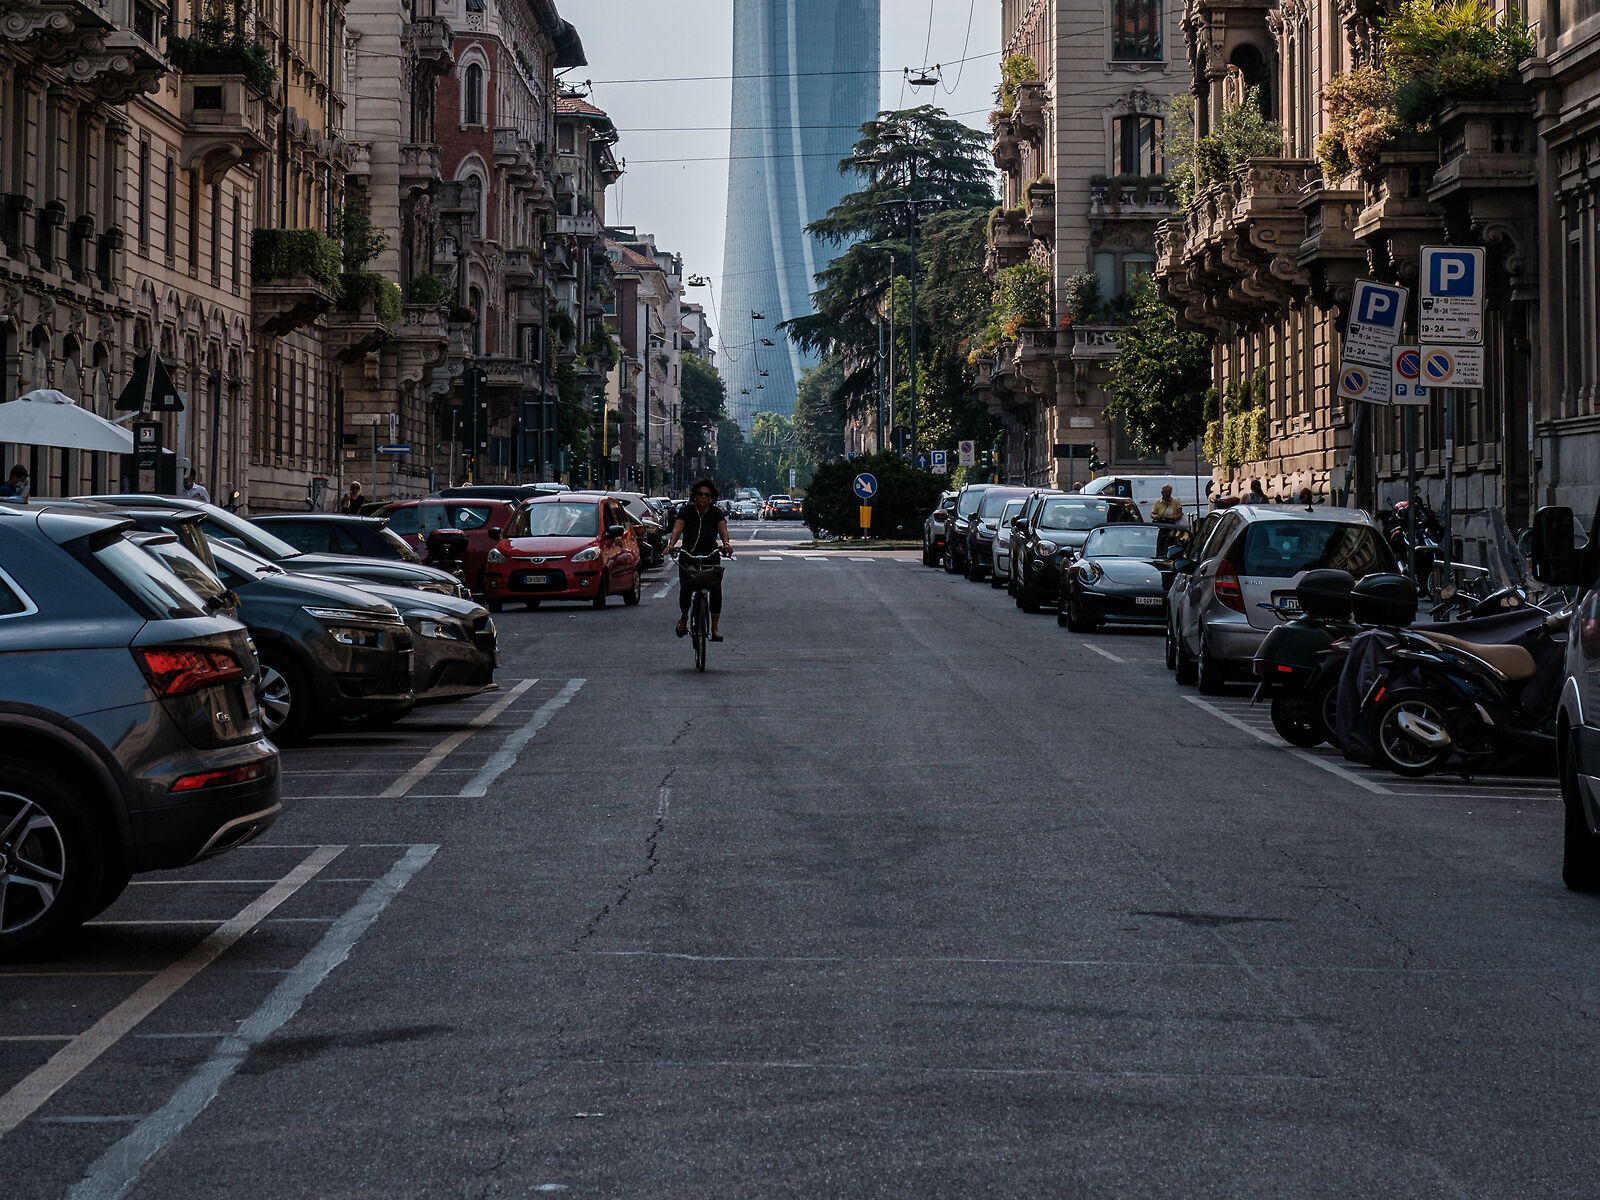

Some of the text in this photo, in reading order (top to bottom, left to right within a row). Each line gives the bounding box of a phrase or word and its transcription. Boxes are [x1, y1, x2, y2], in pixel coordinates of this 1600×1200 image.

[1440, 258, 1466, 291] P
[1366, 292, 1391, 320] P
[1434, 325, 1445, 333] 24
[1397, 385, 1405, 394] P
[143, 429, 152, 437] 51
[935, 454, 943, 463] P
[1118, 485, 1125, 495] P
